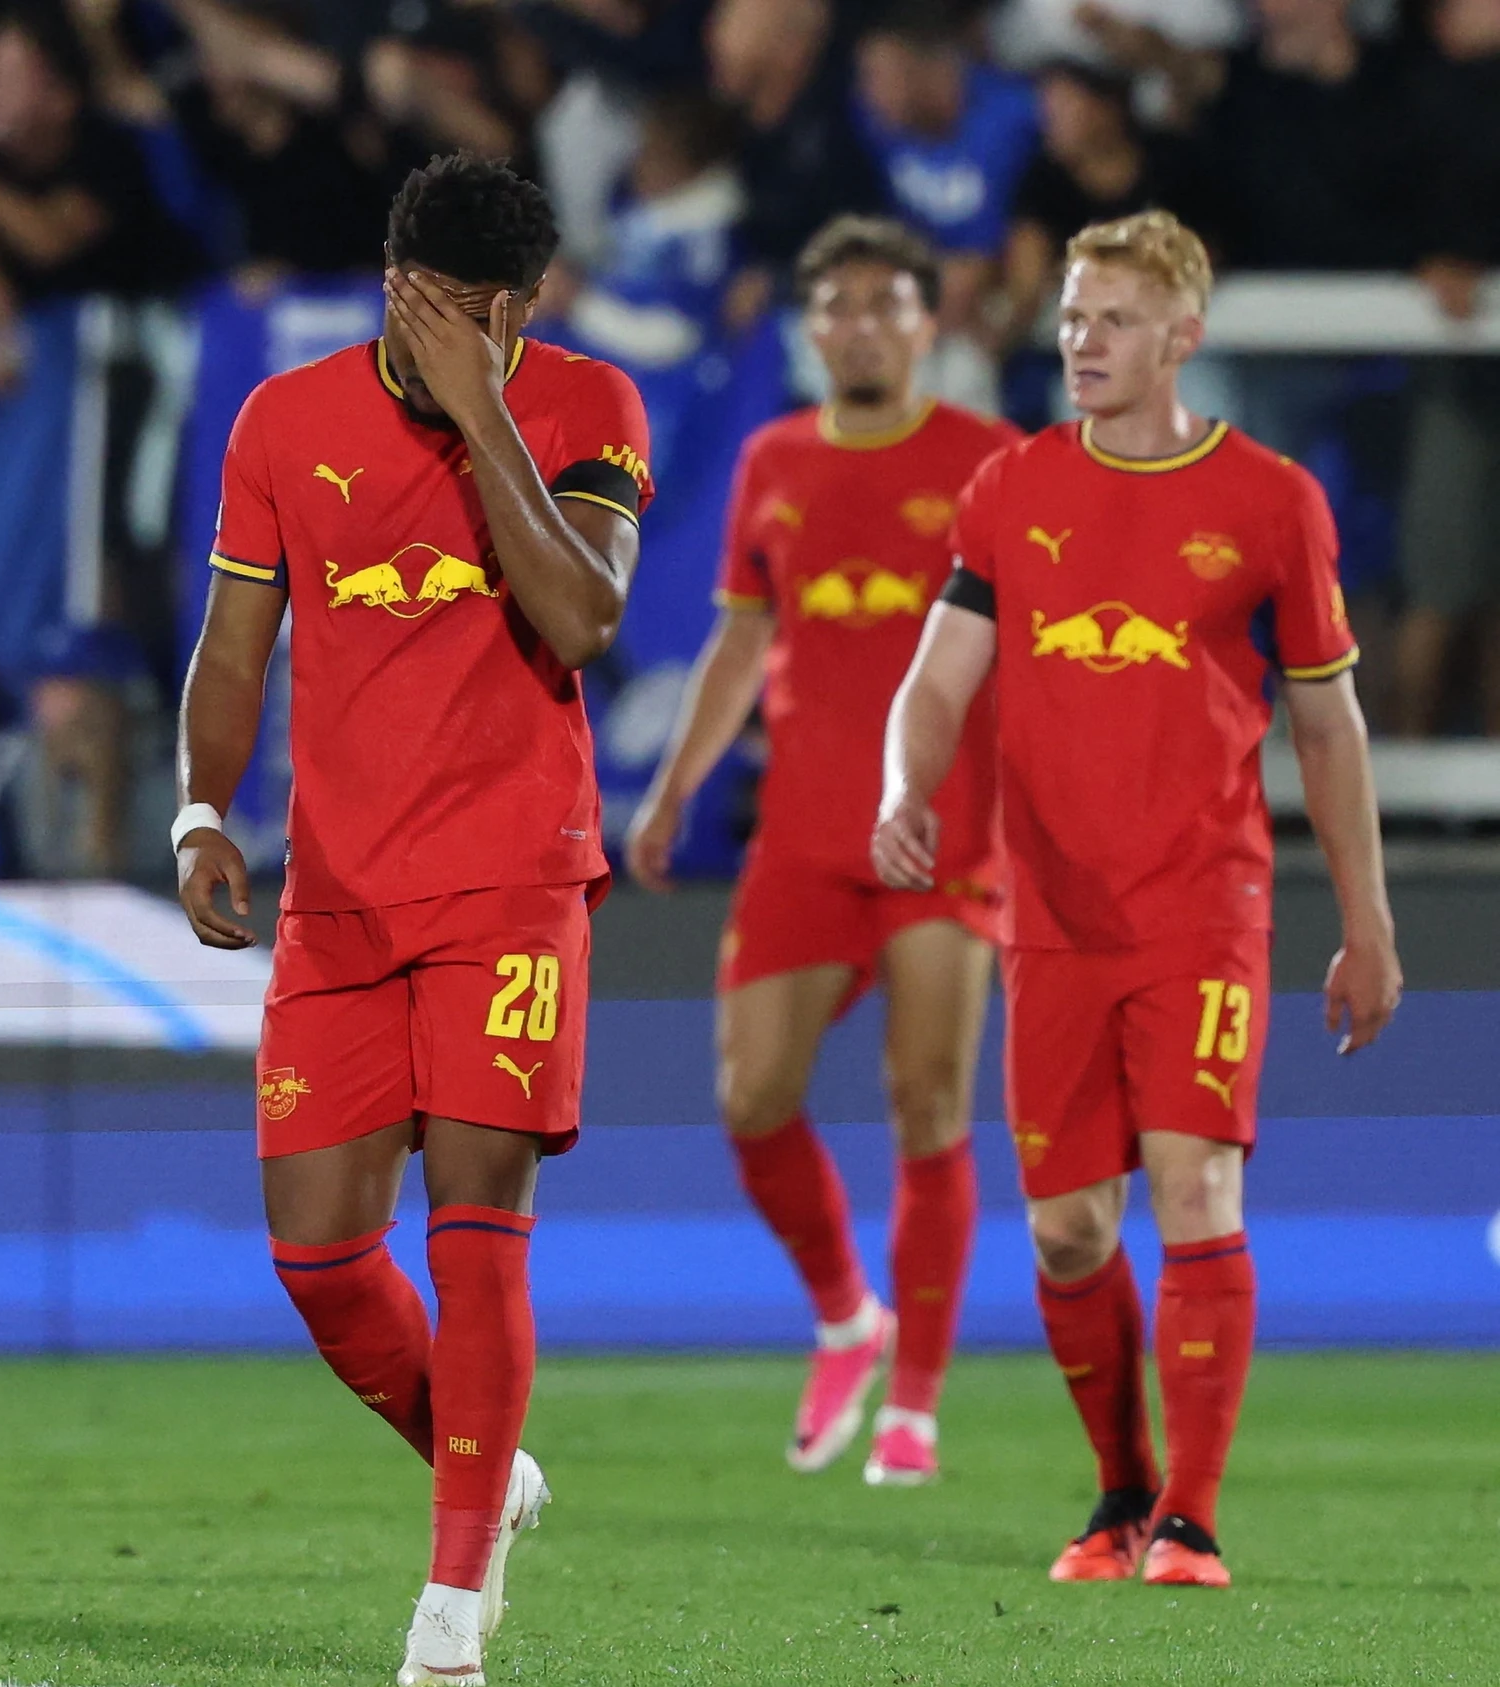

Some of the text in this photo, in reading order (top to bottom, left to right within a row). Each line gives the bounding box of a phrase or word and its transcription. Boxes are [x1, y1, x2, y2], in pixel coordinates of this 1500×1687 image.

[484, 953, 560, 1042] 28
[1193, 978, 1251, 1063] 13
[448, 1435, 482, 1456] RBL
